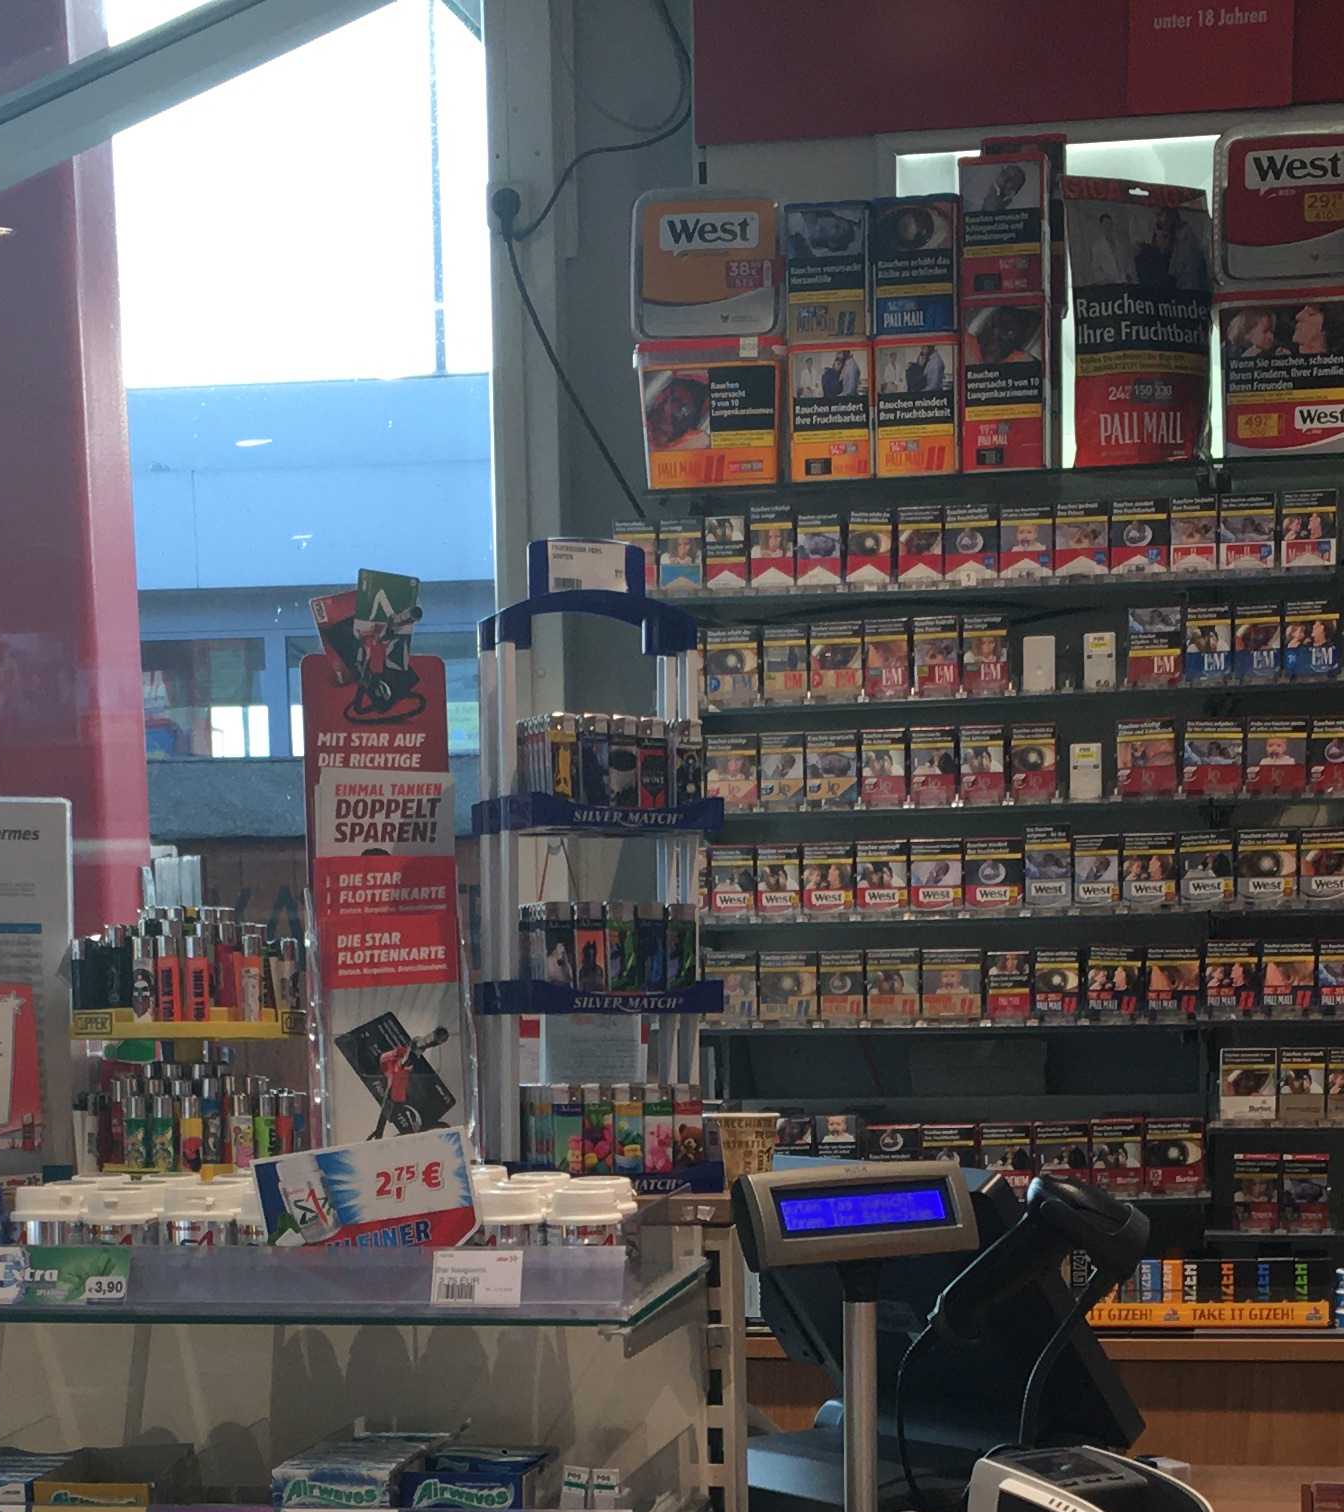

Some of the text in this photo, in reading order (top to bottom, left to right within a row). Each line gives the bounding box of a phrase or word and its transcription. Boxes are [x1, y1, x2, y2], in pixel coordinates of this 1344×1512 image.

[1154, 8, 1267, 29] unter 18 Jahren
[1253, 152, 1342, 181] West
[667, 218, 749, 244] West
[1077, 294, 1156, 319] Rauchen
[1100, 412, 1183, 446] PALL MALL
[317, 733, 426, 747] MIT STAR AUF
[318, 753, 421, 767] DIE RICHTIGE
[642, 775, 665, 783] WINE
[335, 783, 442, 797] EINMAL TANKEN
[335, 798, 441, 819] DOPPELT
[573, 810, 679, 825] SILVER MATCH
[334, 822, 437, 843] SPAREN!
[339, 872, 402, 887] DIE STAR
[339, 887, 446, 903] FLOTTENKARTE
[337, 932, 401, 948] DIE STAR
[338, 946, 446, 964] FLOTTENKARTE
[422, 1162, 442, 1187] €
[1191, 1307, 1295, 1321] TAKE IT GIZEH!
[284, 1478, 378, 1507] Airwaves
